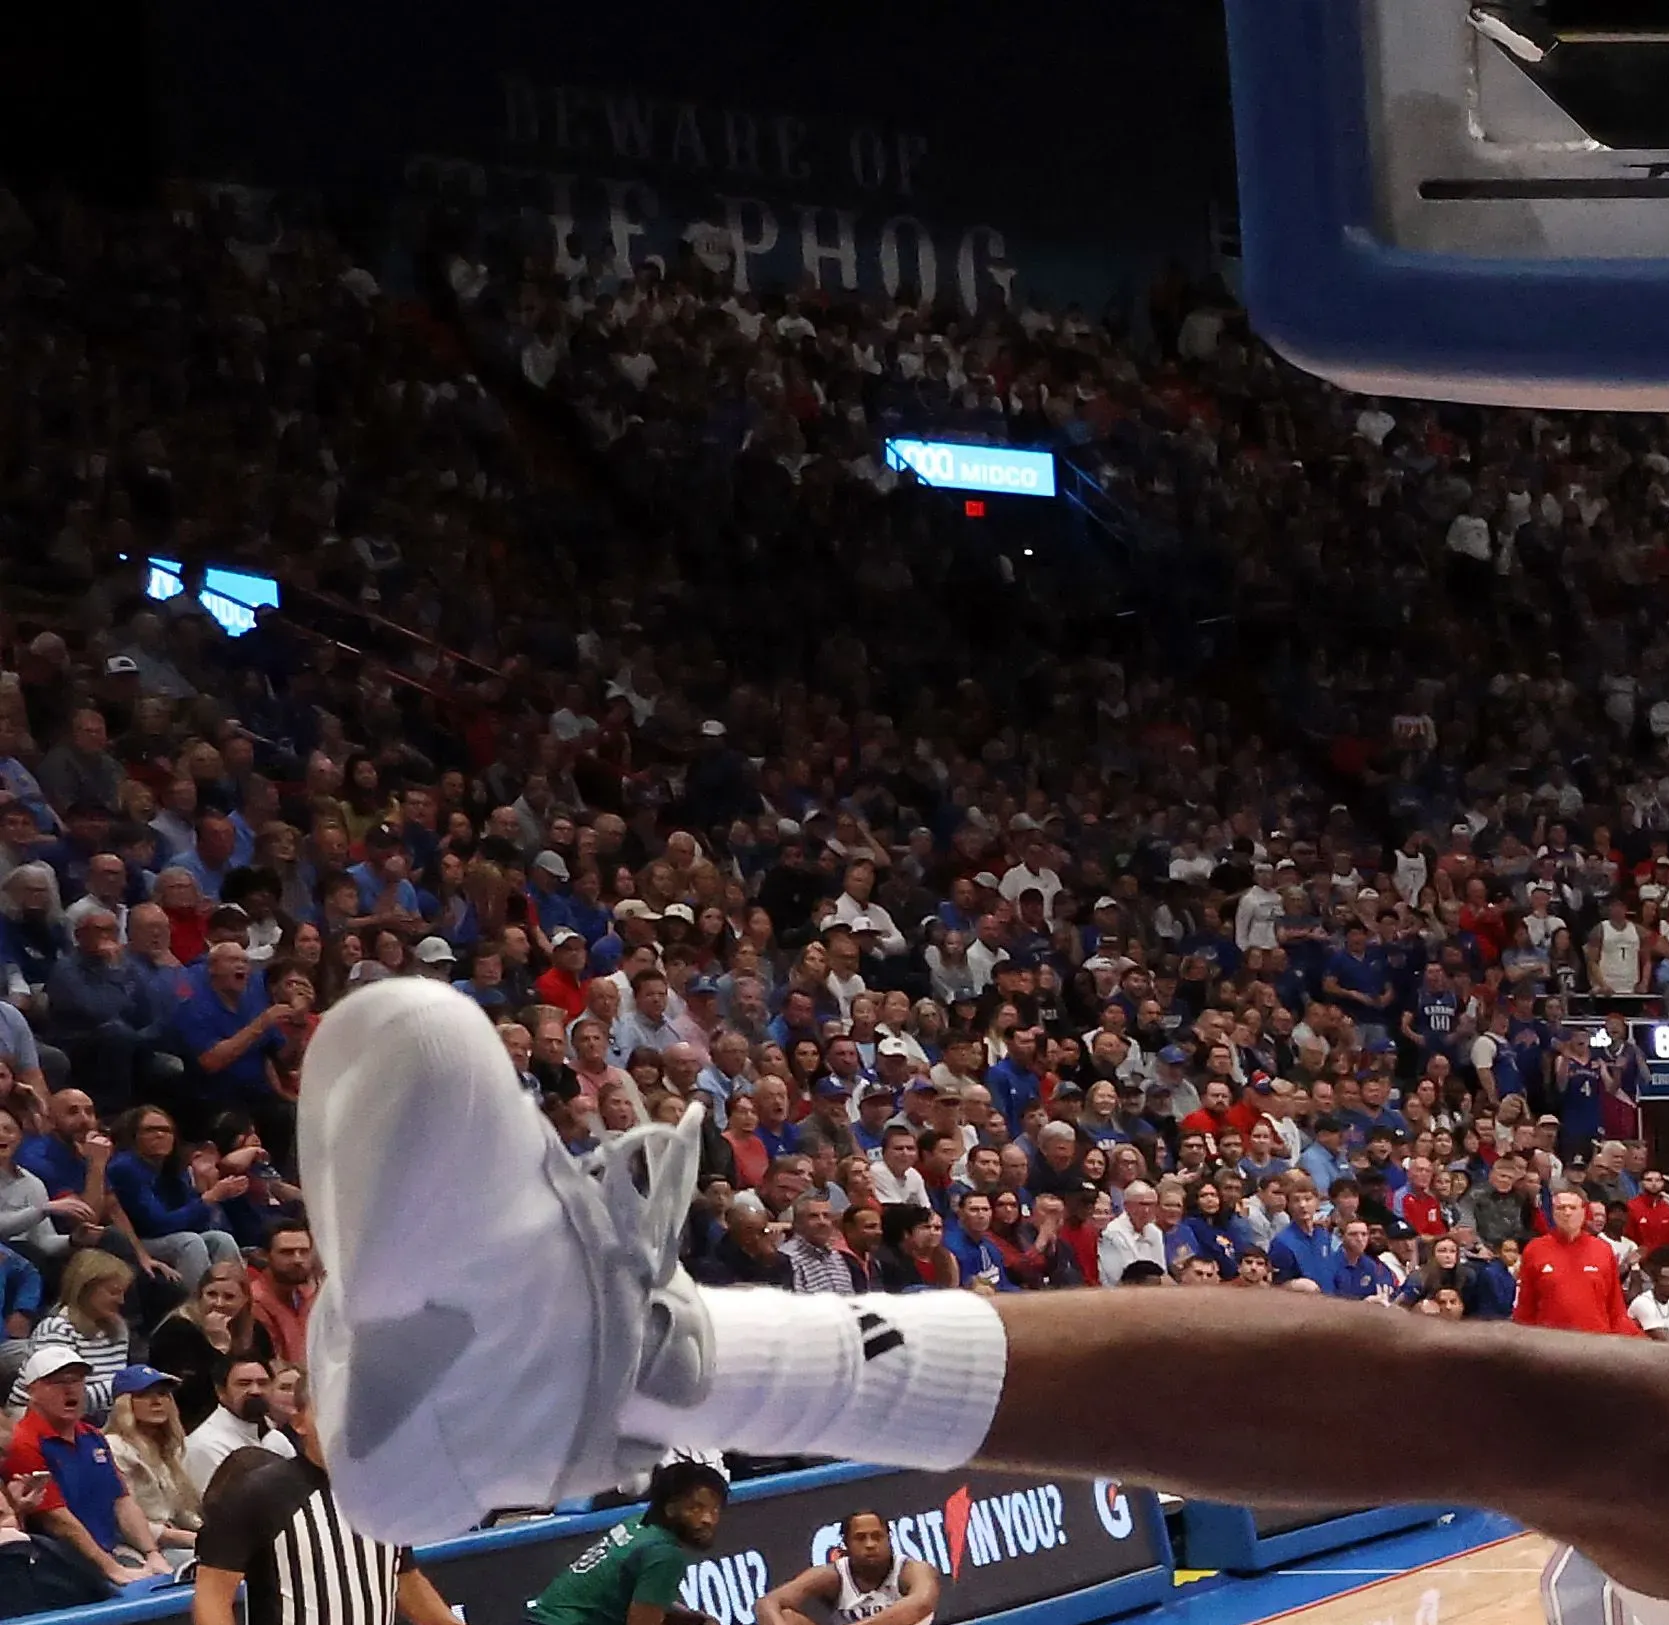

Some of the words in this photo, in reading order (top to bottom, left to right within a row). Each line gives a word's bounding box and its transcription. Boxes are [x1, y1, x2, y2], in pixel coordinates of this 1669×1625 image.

[499, 68, 812, 182] BEWARE
[848, 123, 931, 197] OF
[960, 463, 1037, 489] MIDCO
[1094, 1478, 1134, 1539] G
